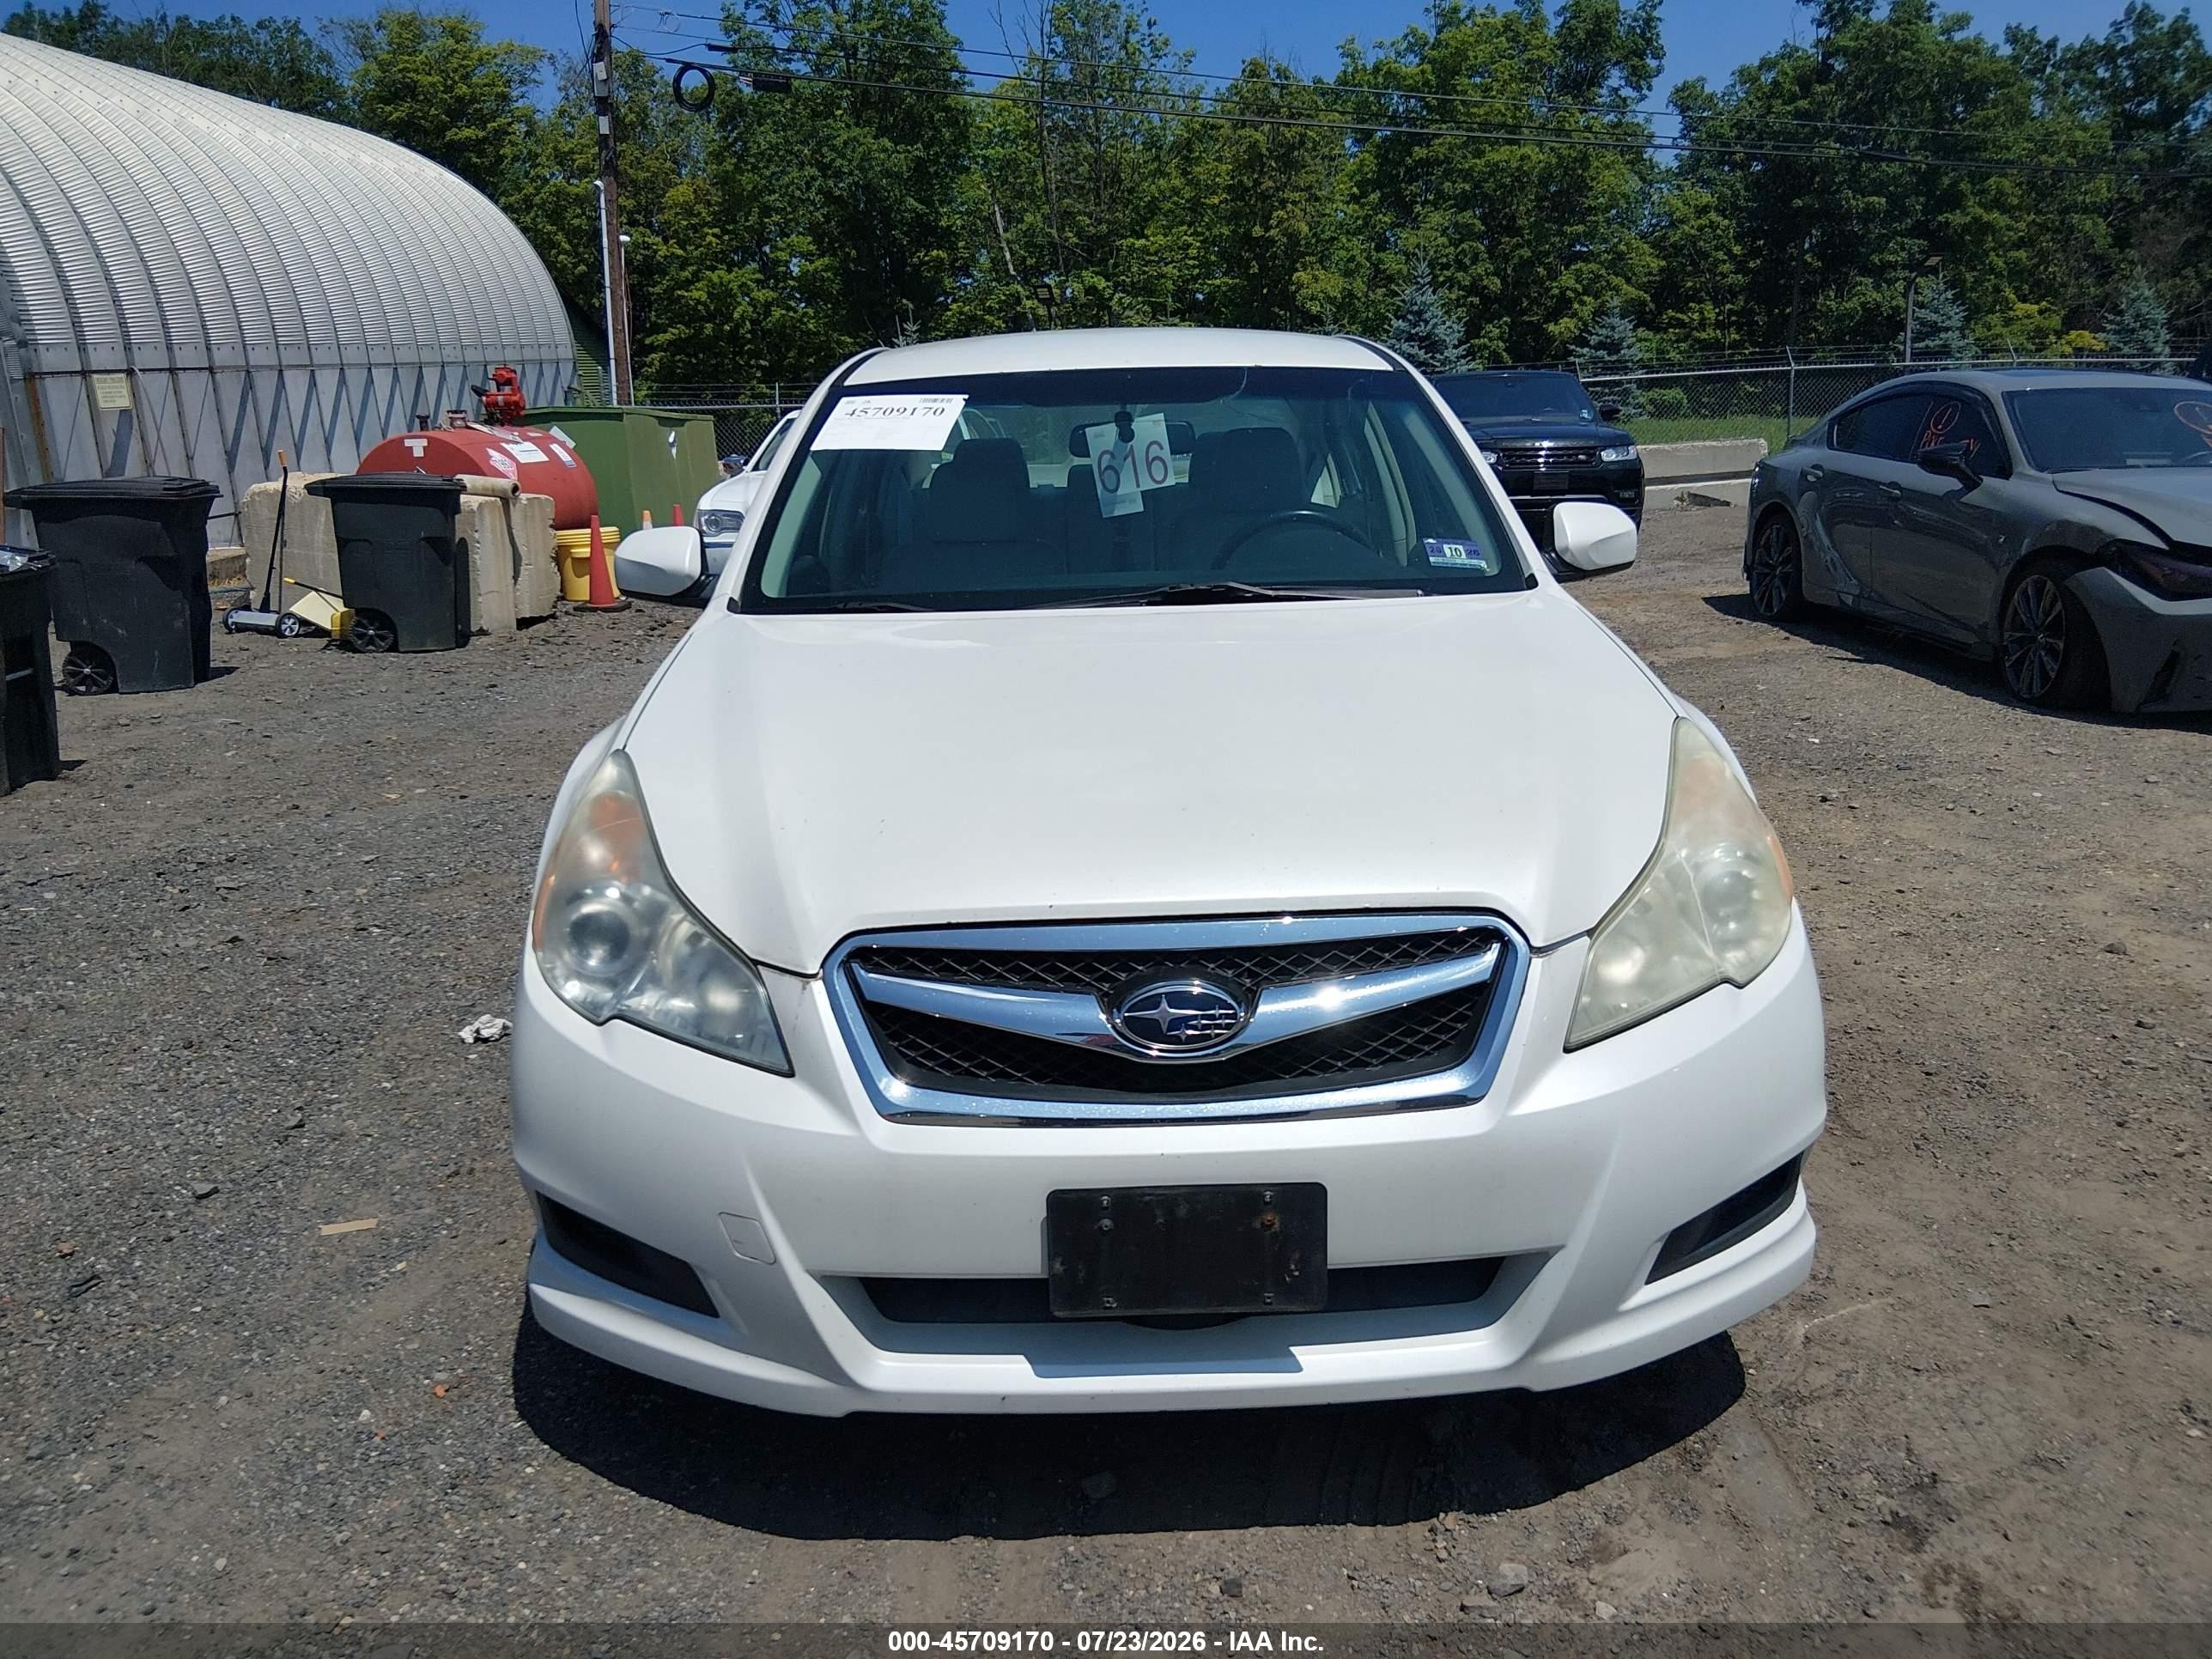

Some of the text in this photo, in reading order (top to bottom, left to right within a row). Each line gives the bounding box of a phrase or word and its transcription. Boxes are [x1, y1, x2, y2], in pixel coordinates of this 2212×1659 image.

[844, 406, 945, 417] 45709170
[1097, 440, 1169, 494] 616
[1448, 546, 1462, 558] 10
